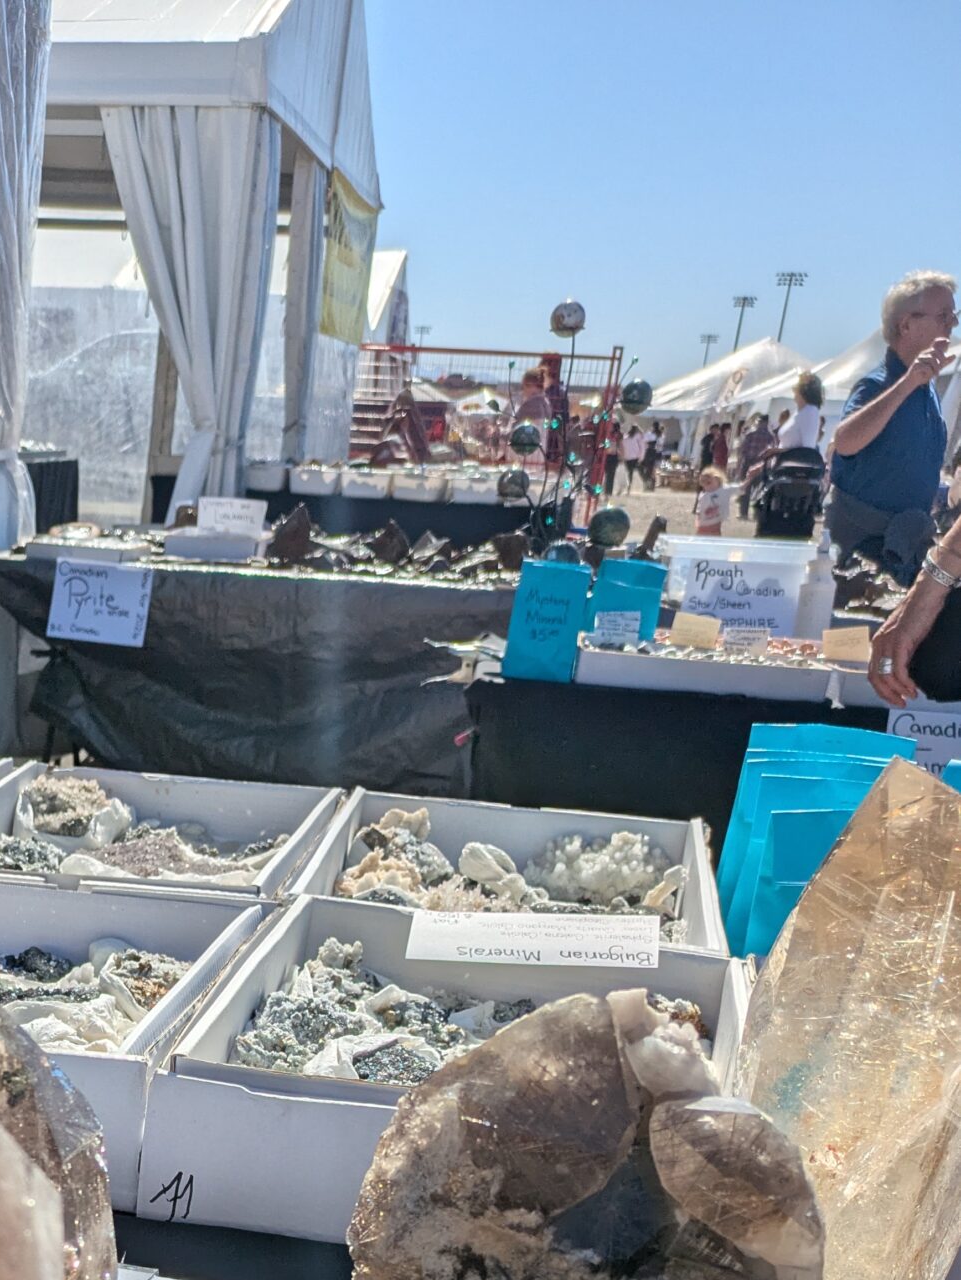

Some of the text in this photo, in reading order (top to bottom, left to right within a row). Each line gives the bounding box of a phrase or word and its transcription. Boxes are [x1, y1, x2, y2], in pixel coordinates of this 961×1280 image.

[695, 560, 743, 590] Rough
[63, 576, 119, 619] Pyrite
[736, 579, 784, 597] Canadian
[526, 589, 570, 609] Mystery
[525, 610, 567, 626] Mineral
[698, 612, 779, 629] APPHIRE
[457, 945, 655, 967] Bulgarian Minerals
